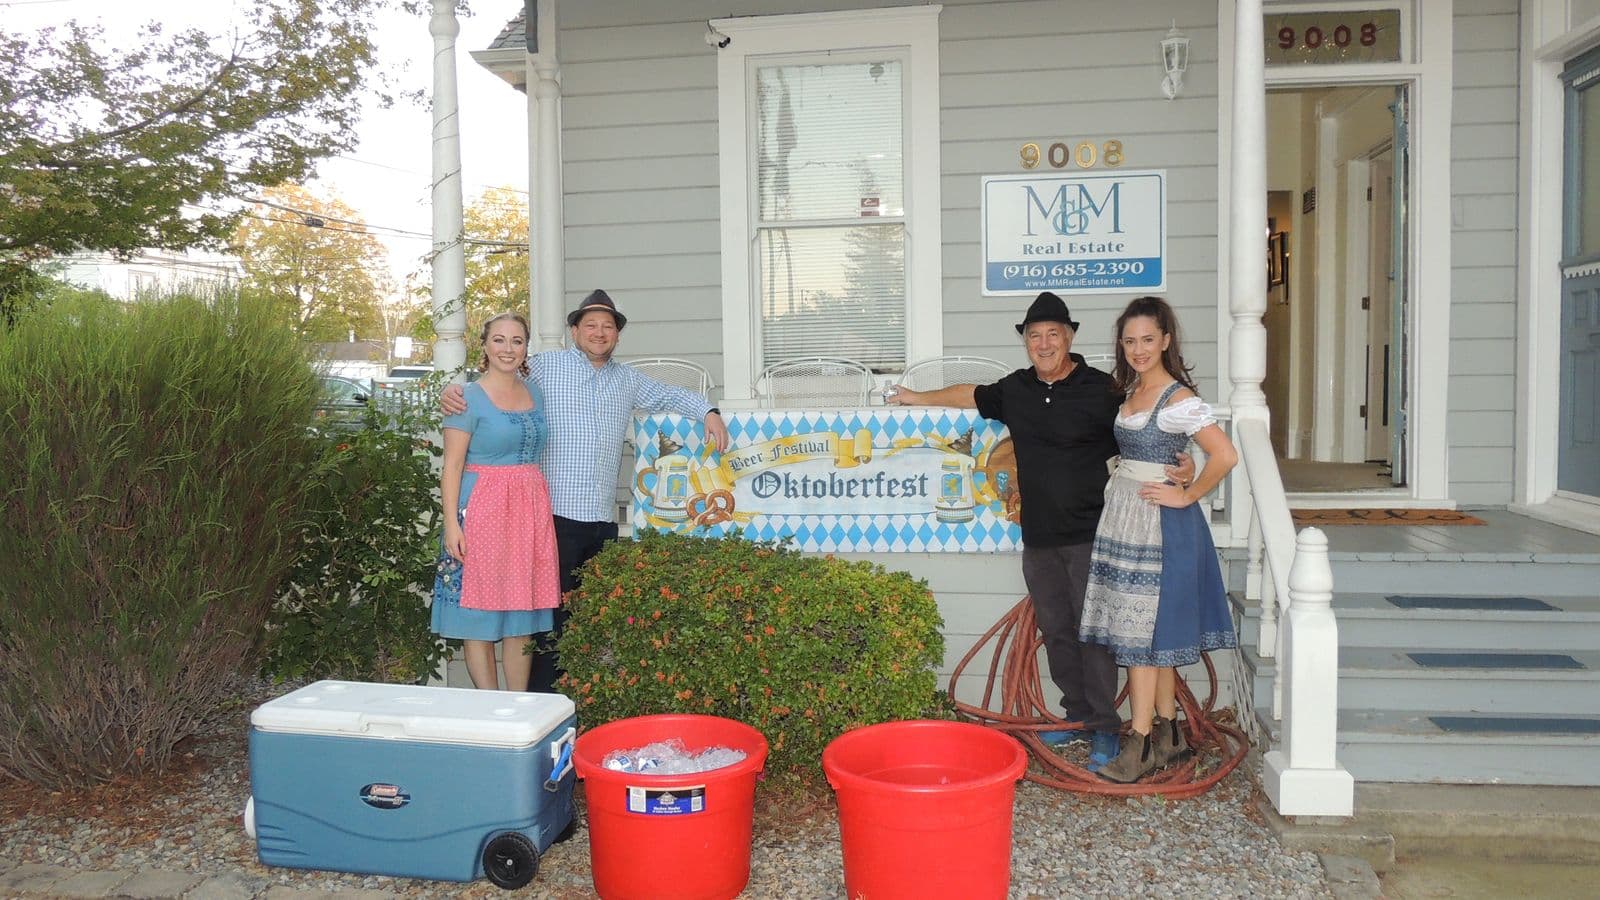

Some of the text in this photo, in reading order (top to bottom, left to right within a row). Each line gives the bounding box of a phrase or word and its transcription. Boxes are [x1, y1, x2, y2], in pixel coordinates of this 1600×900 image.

[1278, 23, 1377, 49] 9008
[1020, 140, 1125, 169] 9008
[1023, 241, 1125, 255] Real Estate
[1003, 261, 1144, 280] (916) 685-2390
[1024, 278, 1125, 288] www.MMRealEstate.net
[729, 439, 830, 472] Beer Festival
[751, 471, 929, 499] Oktoberfest
